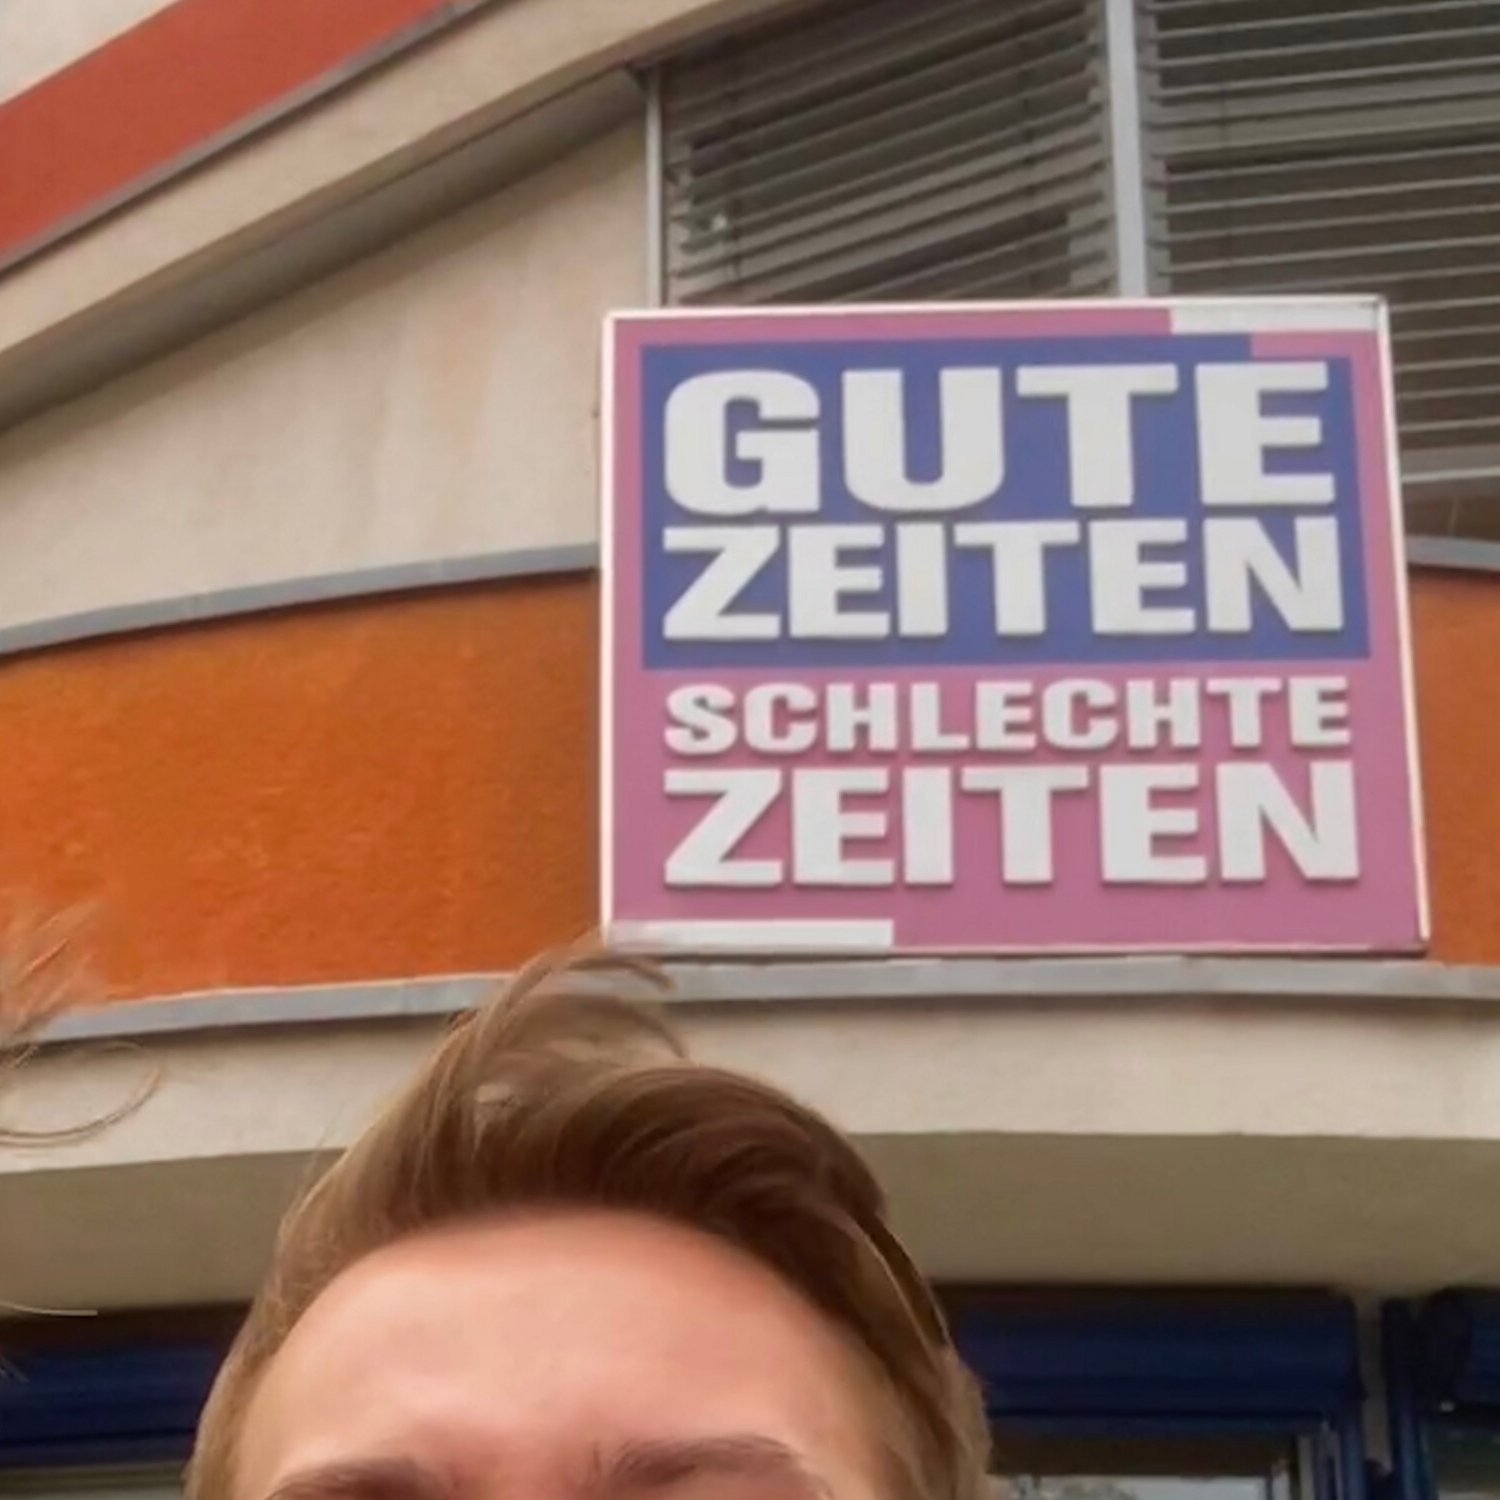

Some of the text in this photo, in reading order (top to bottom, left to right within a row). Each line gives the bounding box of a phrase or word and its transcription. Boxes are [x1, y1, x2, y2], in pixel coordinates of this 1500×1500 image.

[664, 362, 1336, 516] GUTE
[662, 516, 1344, 640] ZEITEN
[663, 676, 1352, 756] SCHLECHTE
[663, 761, 1361, 888] ZEITEN
